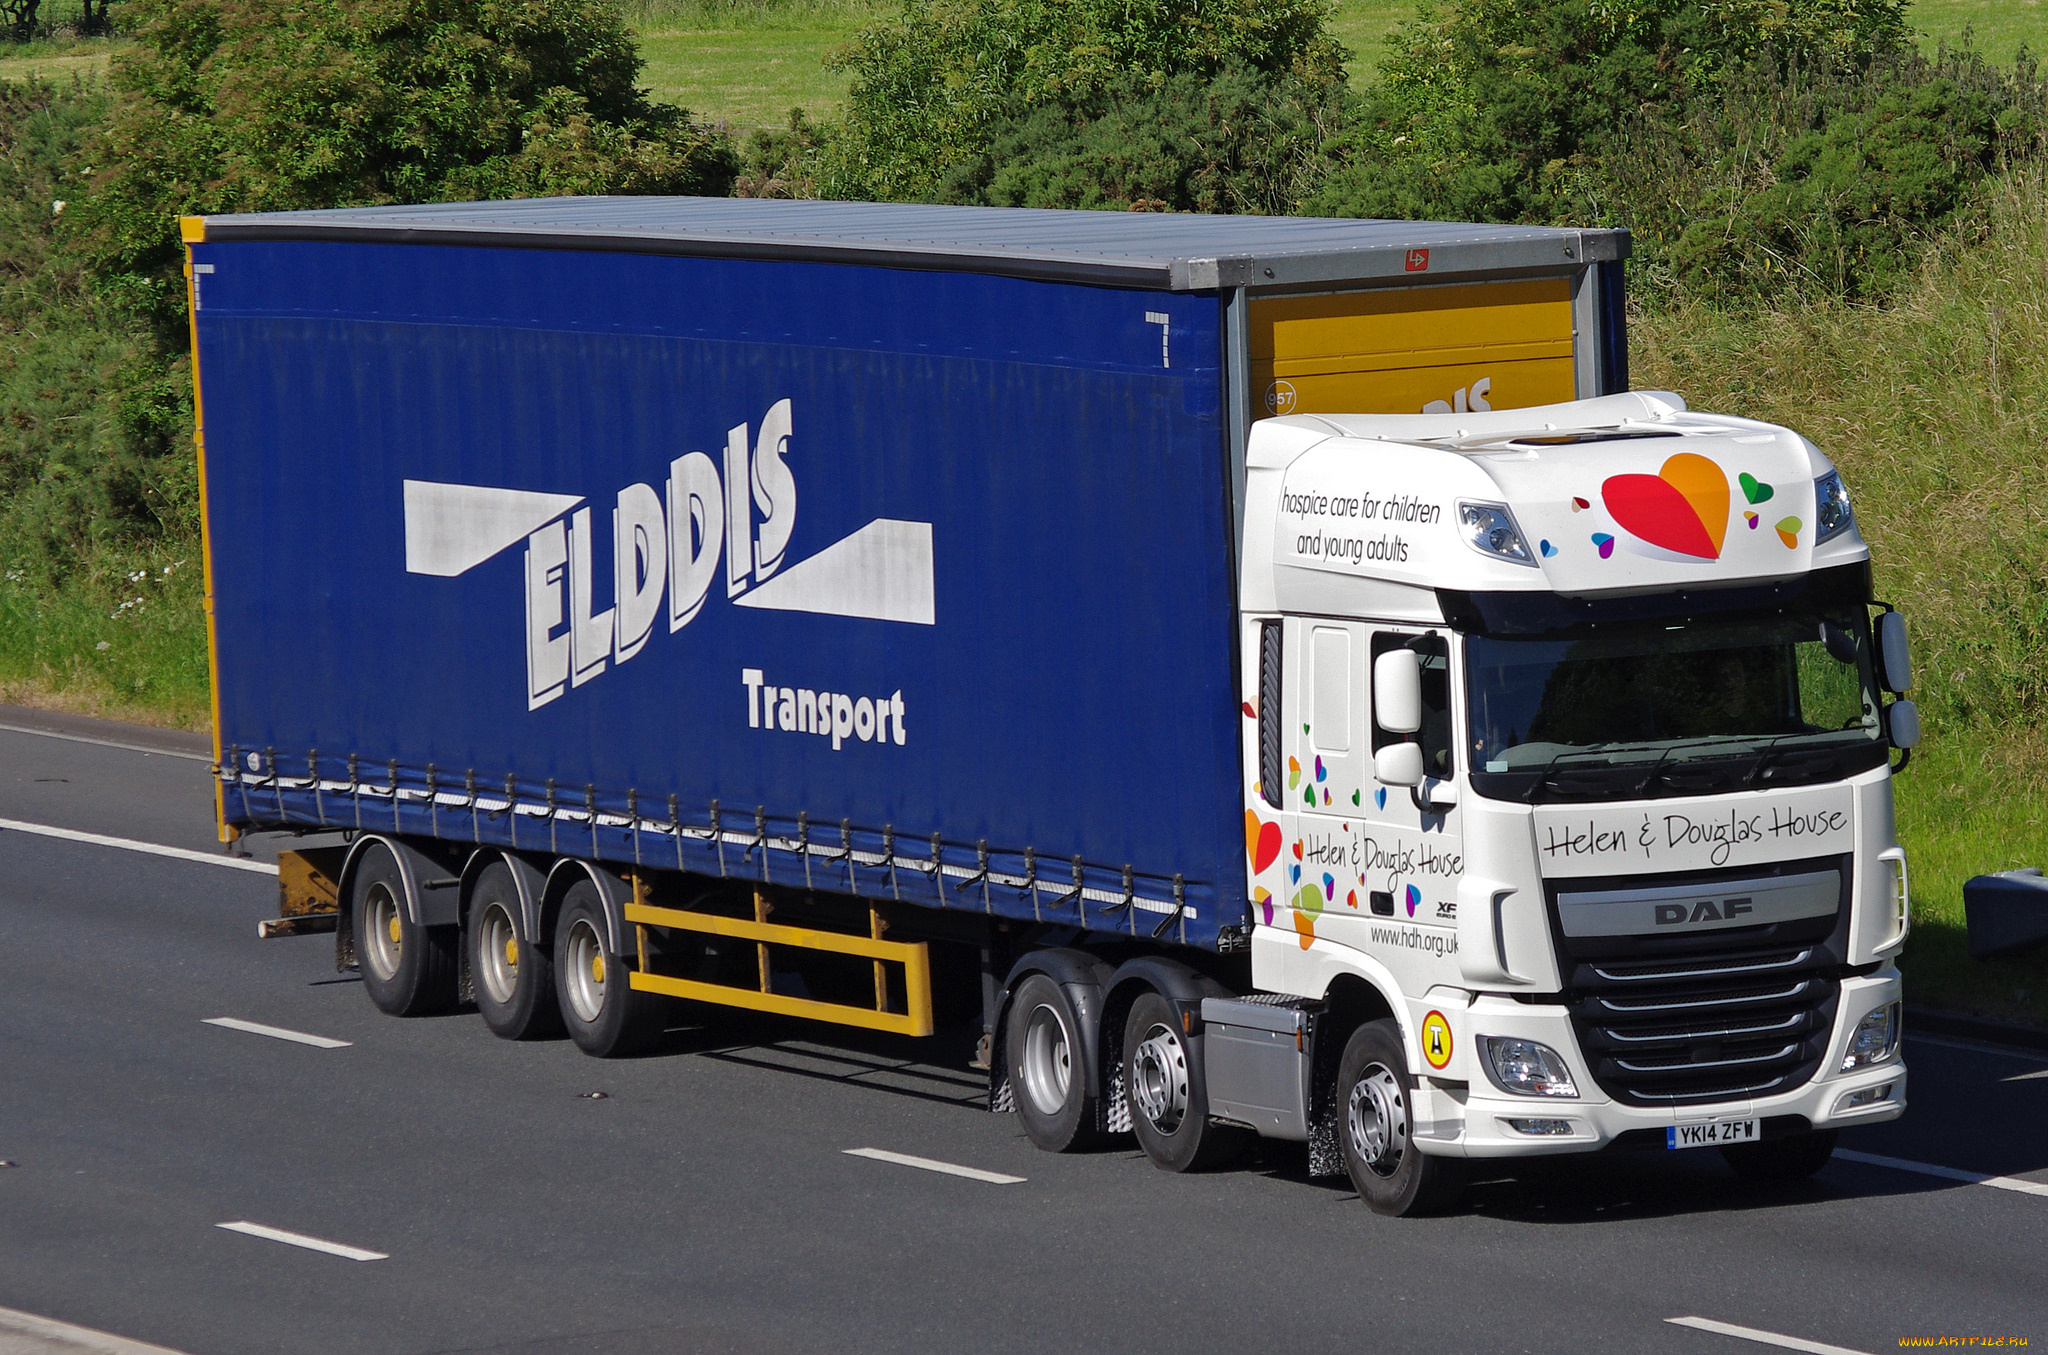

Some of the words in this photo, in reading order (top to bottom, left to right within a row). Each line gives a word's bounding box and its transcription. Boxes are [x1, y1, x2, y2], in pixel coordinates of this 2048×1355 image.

[1267, 392, 1293, 405] 957
[1281, 486, 1327, 521] hospice
[1330, 494, 1358, 519] care
[1361, 491, 1380, 519] for
[1382, 494, 1441, 525] children
[524, 397, 797, 712] ELDDIS
[1297, 529, 1322, 556] and
[1323, 536, 1363, 565] young
[1366, 534, 1408, 563] adults
[742, 668, 907, 751] Transport
[1544, 821, 1627, 856] Helen
[1639, 813, 1656, 858] &
[1663, 808, 1762, 866] Douglas
[1768, 807, 1848, 837] House
[1307, 832, 1347, 867] Helen
[1351, 832, 1361, 877] &
[1364, 837, 1416, 893] Douglas
[1418, 843, 1464, 877] House
[1437, 901, 1457, 913] XF
[1655, 897, 1752, 925] DAF
[1371, 926, 1459, 958] www.hdh.org.uk
[1681, 1124, 1717, 1144] YK14
[1722, 1120, 1754, 1140] ZFW
